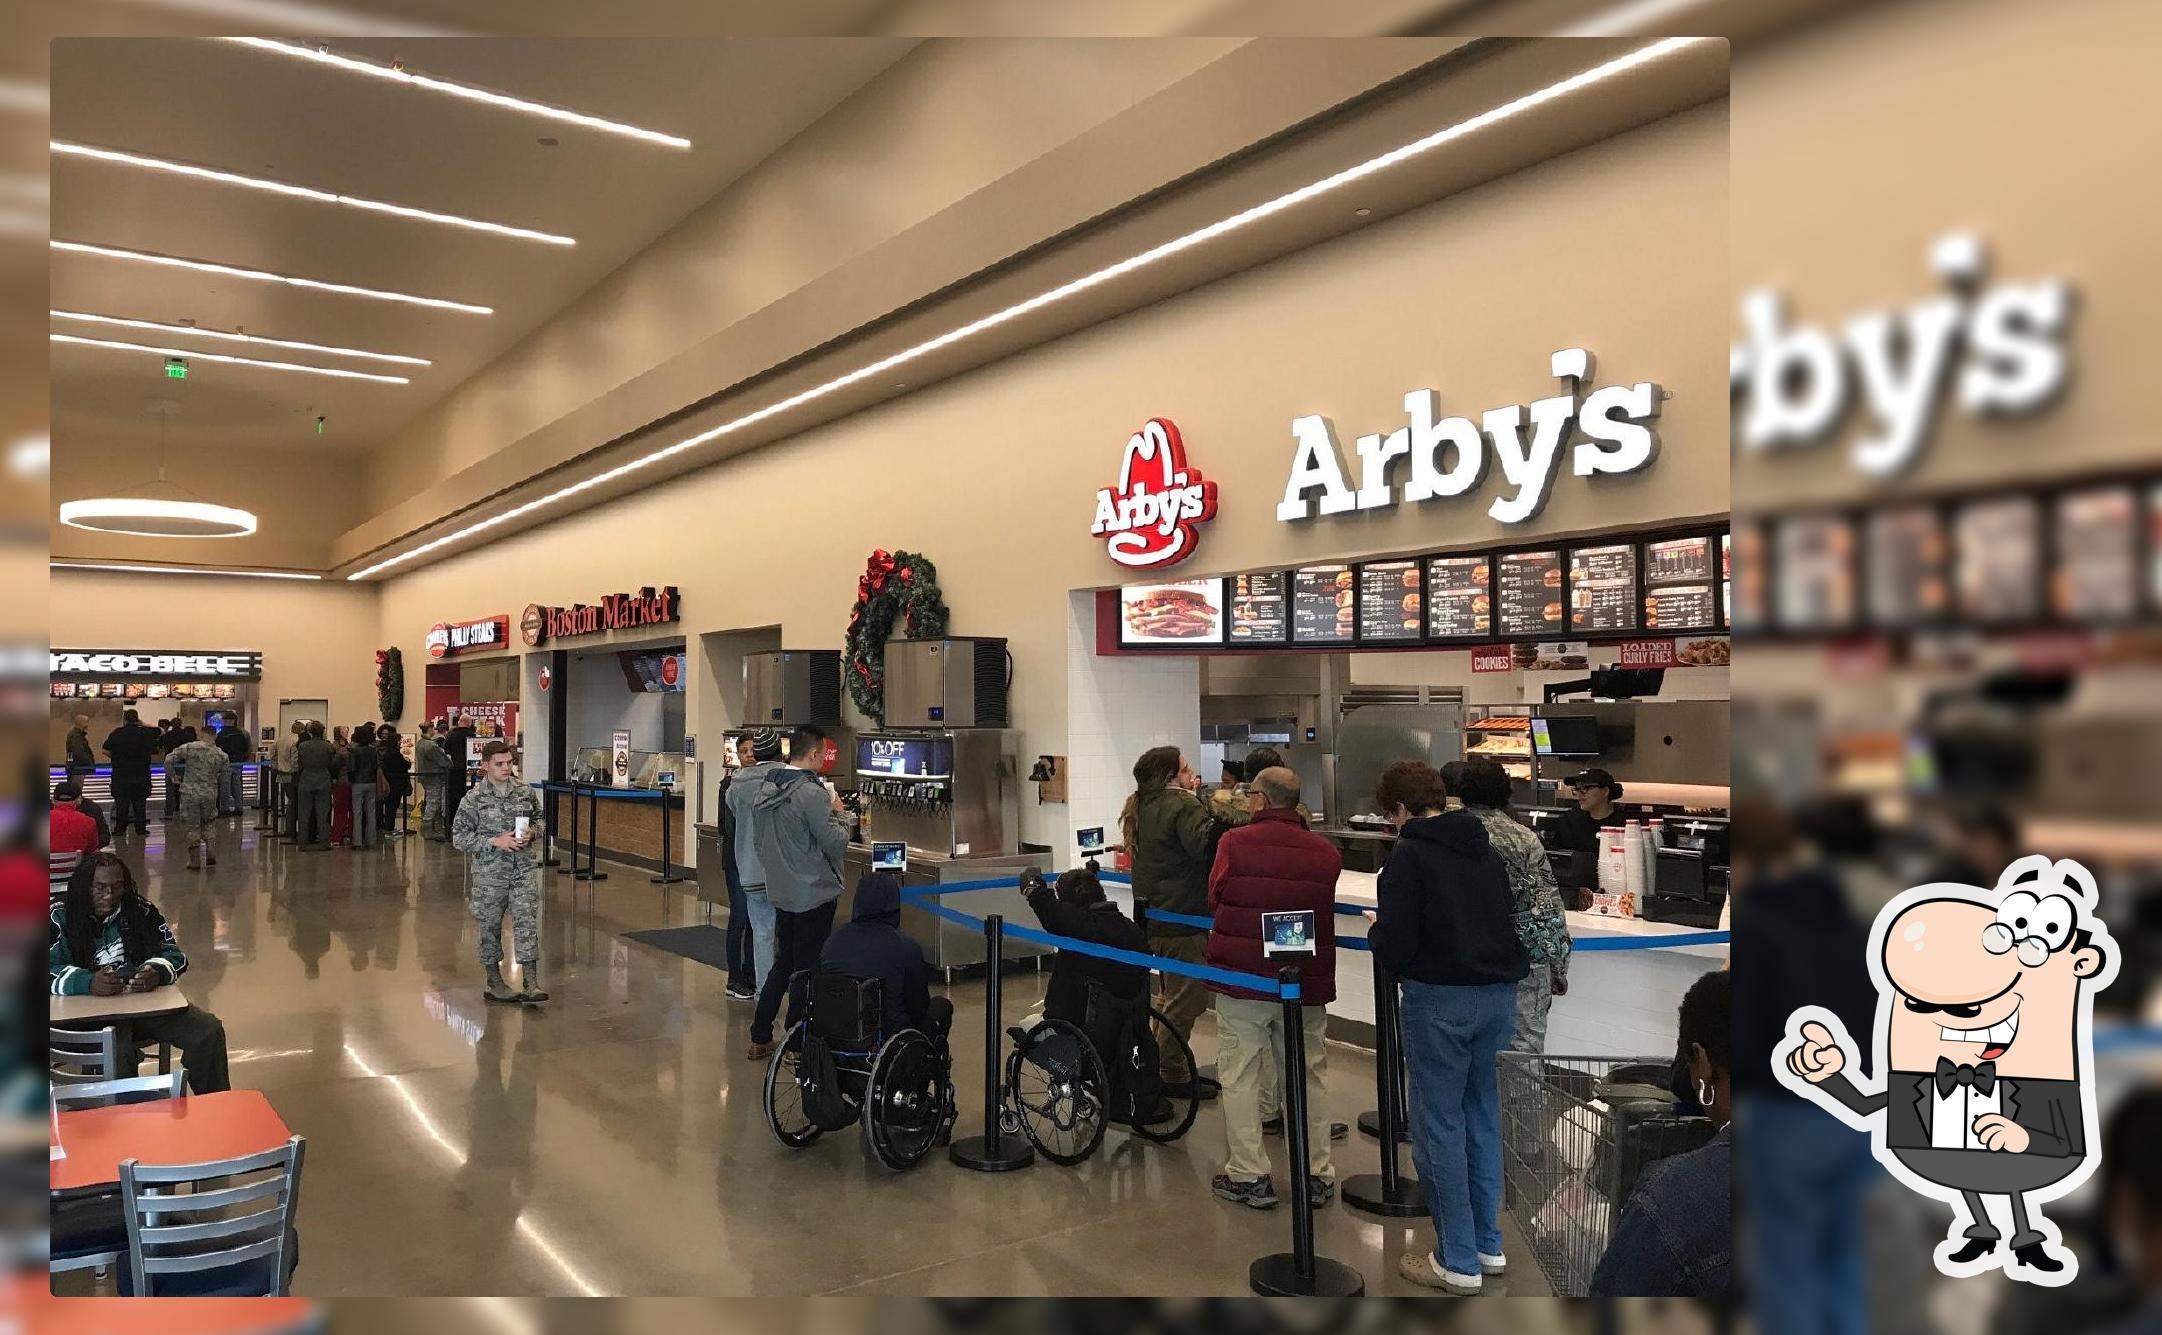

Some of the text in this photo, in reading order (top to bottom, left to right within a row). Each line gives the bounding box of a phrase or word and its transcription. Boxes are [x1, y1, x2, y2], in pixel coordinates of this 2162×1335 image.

[1730, 228, 2066, 478] by's
[1277, 348, 1655, 525] Arby's
[1091, 472, 1203, 536] Arby's
[546, 588, 674, 638] Boston Market
[471, 621, 495, 645] STEAKS
[1622, 642, 1672, 652] LOADED
[1623, 650, 1672, 664] CURLY FRIES
[50, 653, 249, 674] TACO BELL
[1474, 656, 1509, 670] COOKIES
